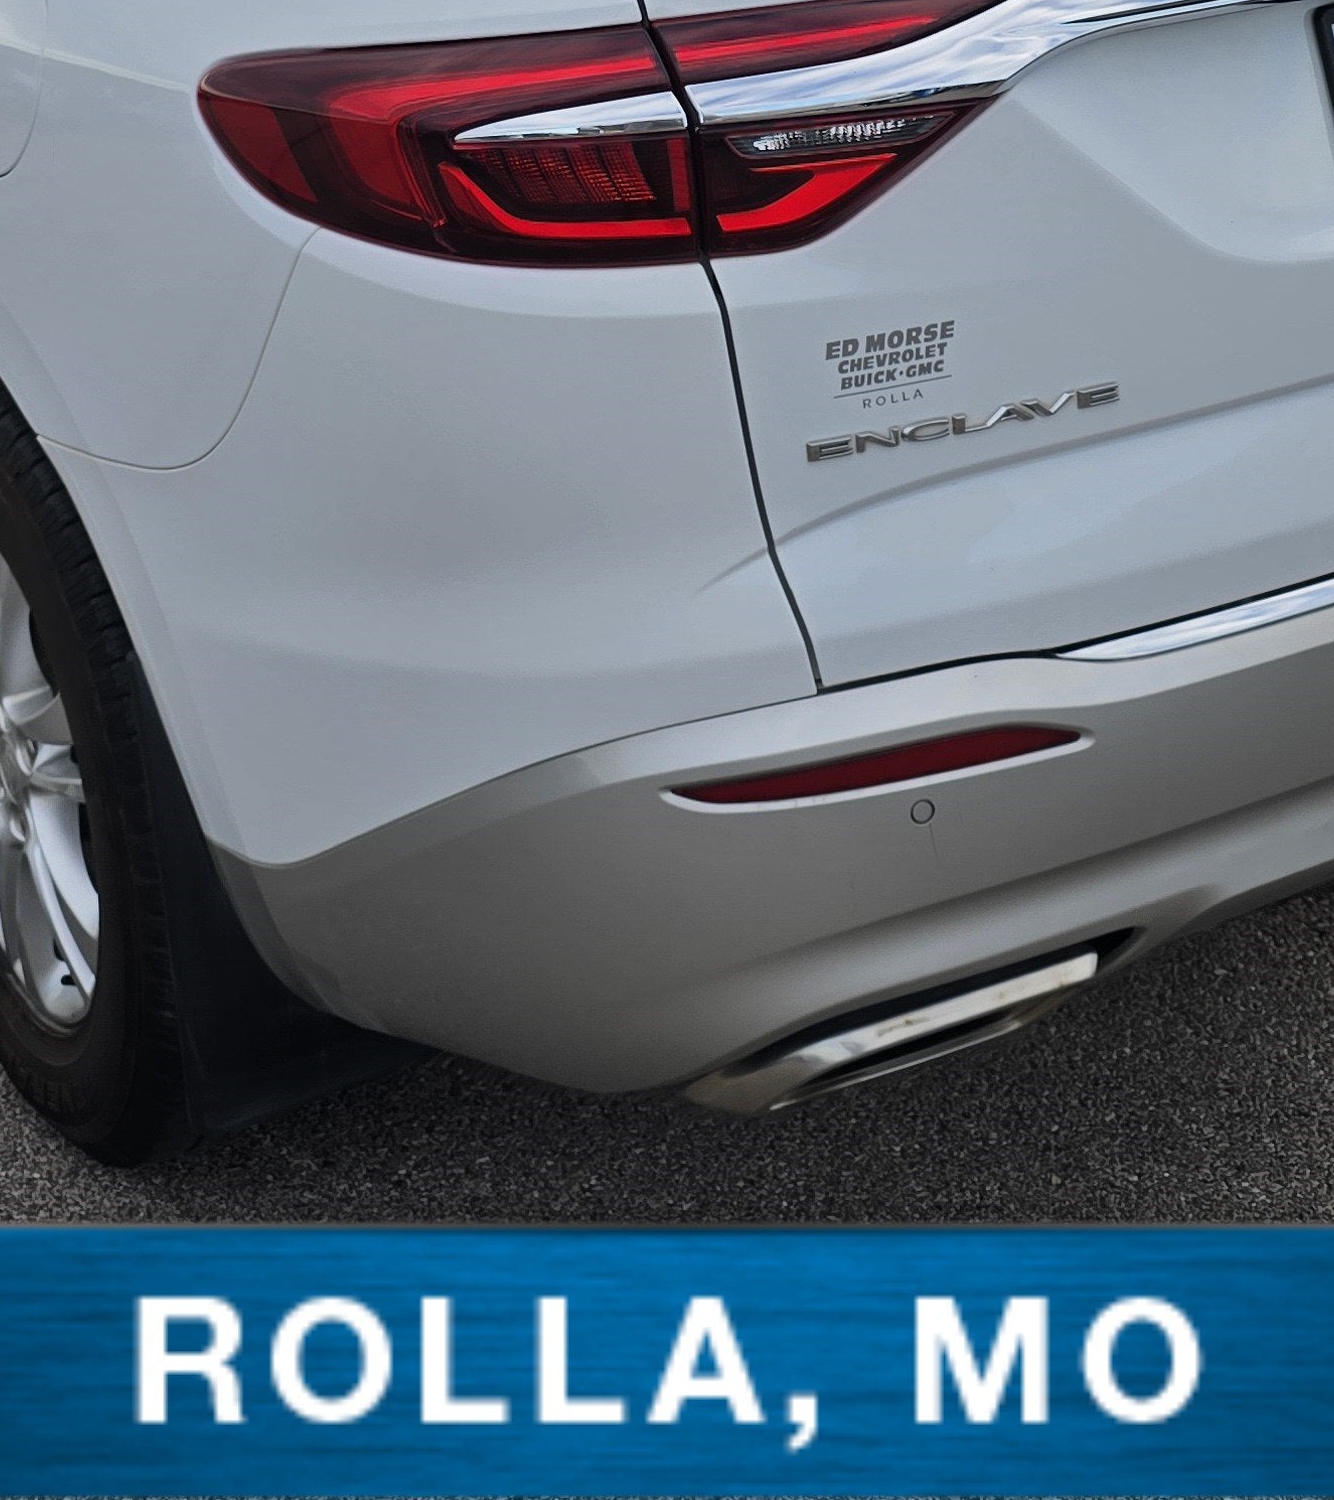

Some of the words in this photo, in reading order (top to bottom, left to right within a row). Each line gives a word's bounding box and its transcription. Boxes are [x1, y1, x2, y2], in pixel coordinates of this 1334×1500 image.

[825, 338, 860, 361] ED
[864, 319, 955, 354] MORSE
[837, 341, 948, 375] CHEVROLET
[862, 387, 925, 410] ROLLA
[805, 380, 1121, 463] ENCLAVE
